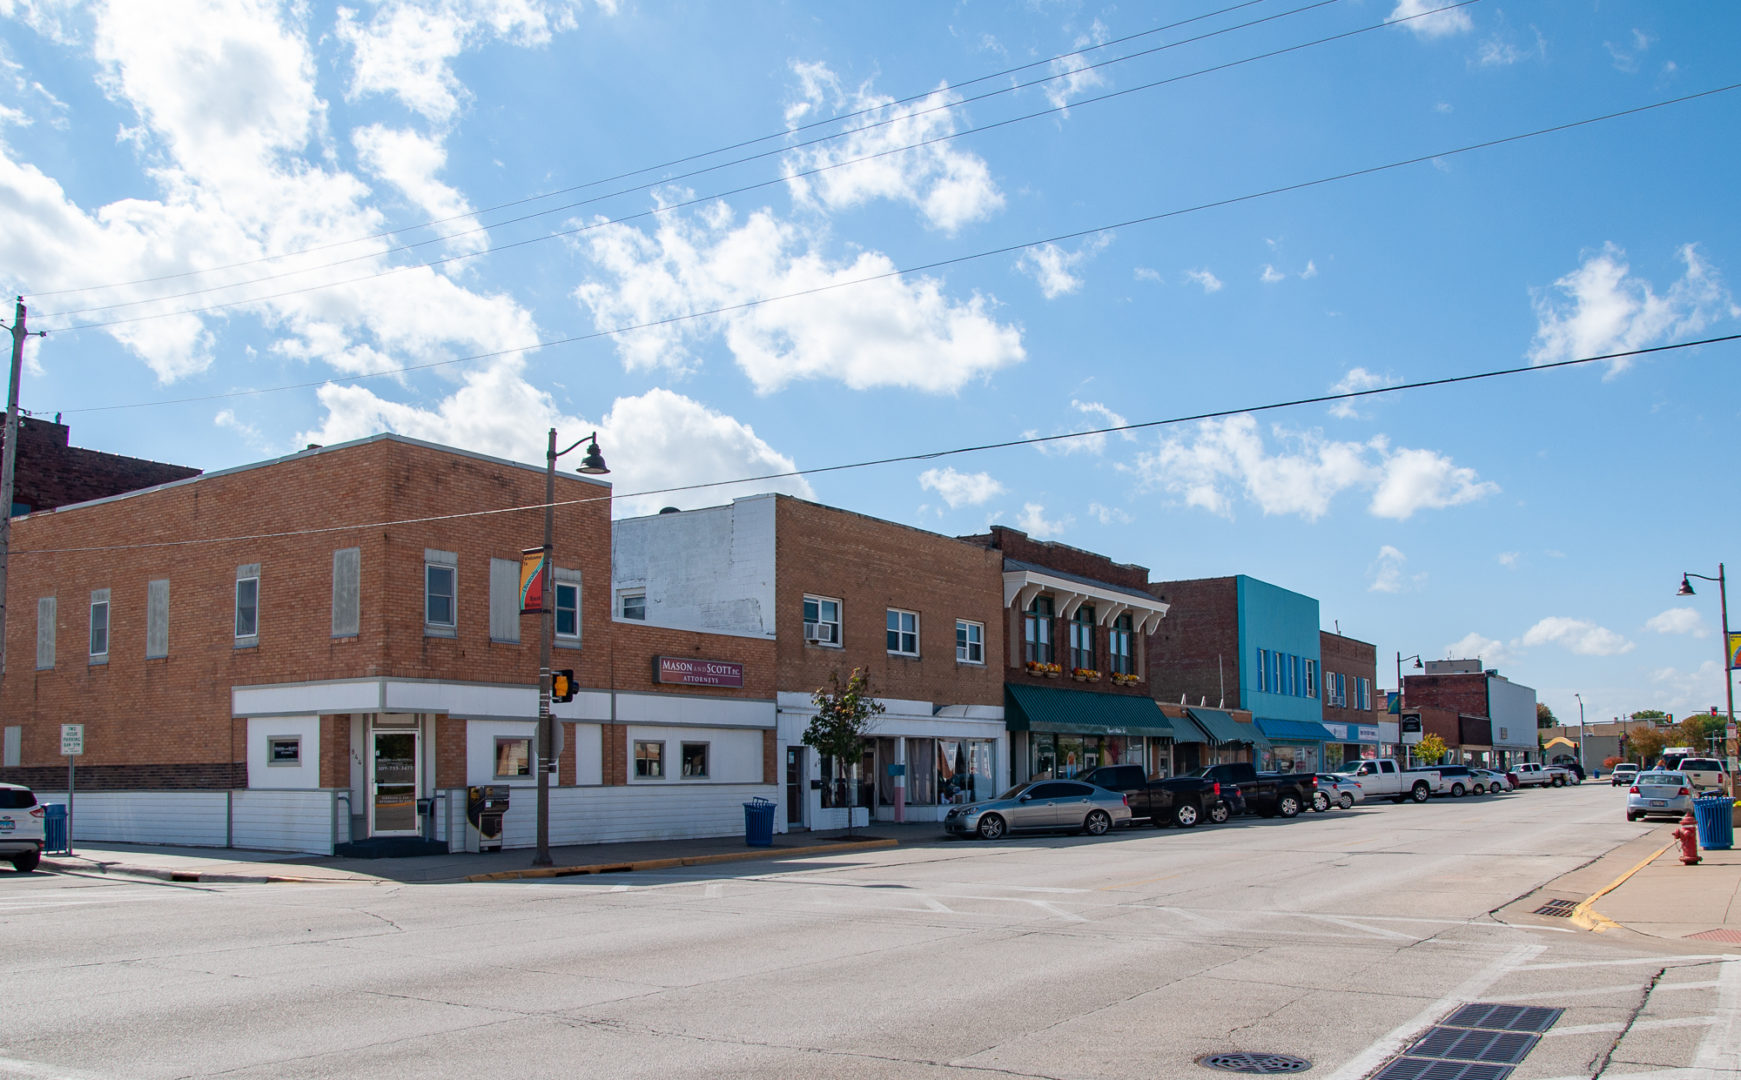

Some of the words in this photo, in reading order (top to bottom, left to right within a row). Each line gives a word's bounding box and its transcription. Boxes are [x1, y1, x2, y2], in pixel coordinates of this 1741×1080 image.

[662, 660, 693, 671] MASON
[694, 665, 706, 673] AND
[706, 663, 732, 675] SCOTT
[683, 675, 719, 684] ATTORNEYS
